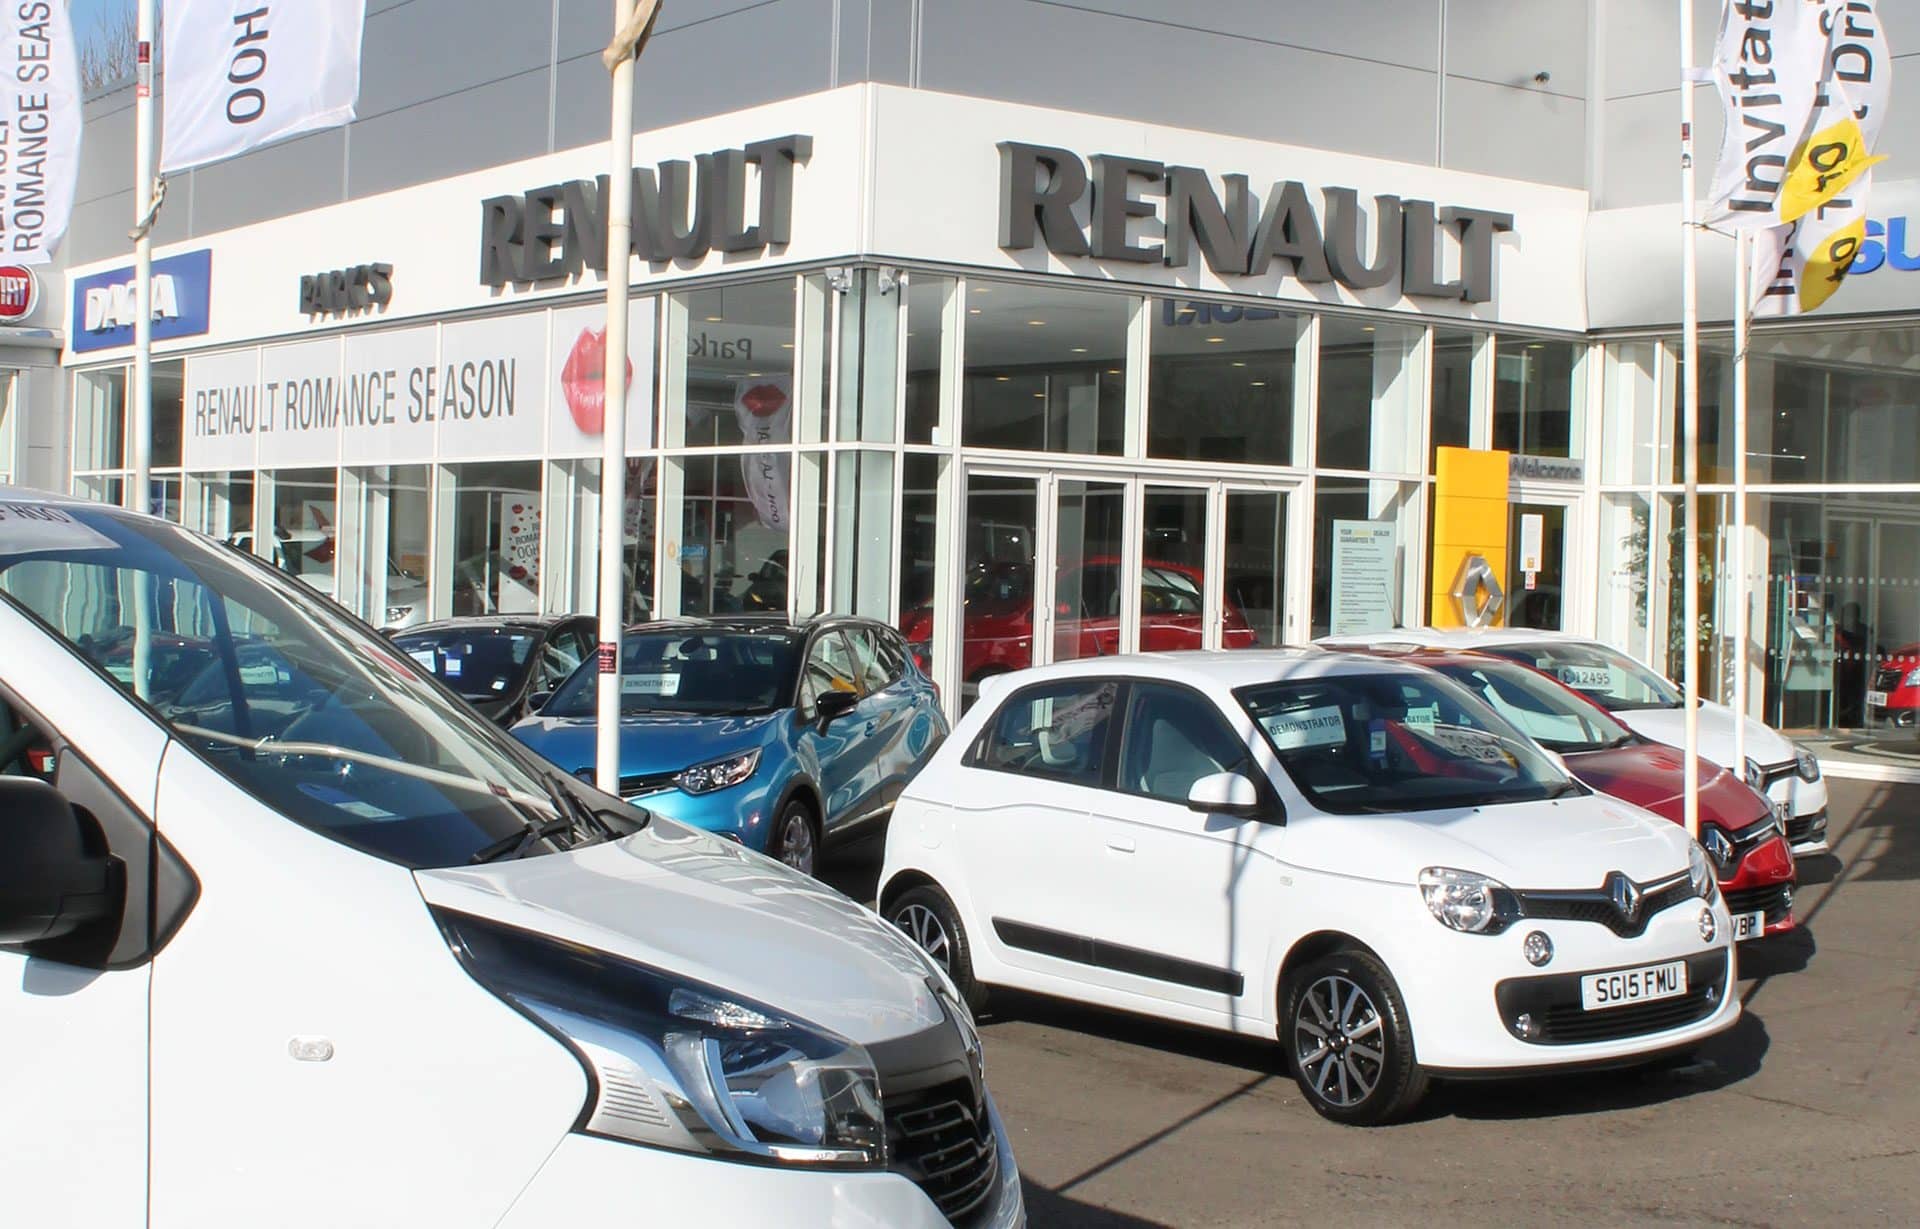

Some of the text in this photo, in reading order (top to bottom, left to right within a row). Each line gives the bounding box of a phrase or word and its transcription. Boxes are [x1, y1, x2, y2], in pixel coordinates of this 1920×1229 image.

[225, 6, 269, 125] OOH
[12, 92, 50, 252] ROMANCE
[996, 140, 1514, 305] RENAULT
[195, 357, 516, 437] RENAULT ROMANCE SEASON
[1269, 715, 1342, 736] DEMONSTRATOR
[1596, 967, 1678, 1002] SG15 FMU
